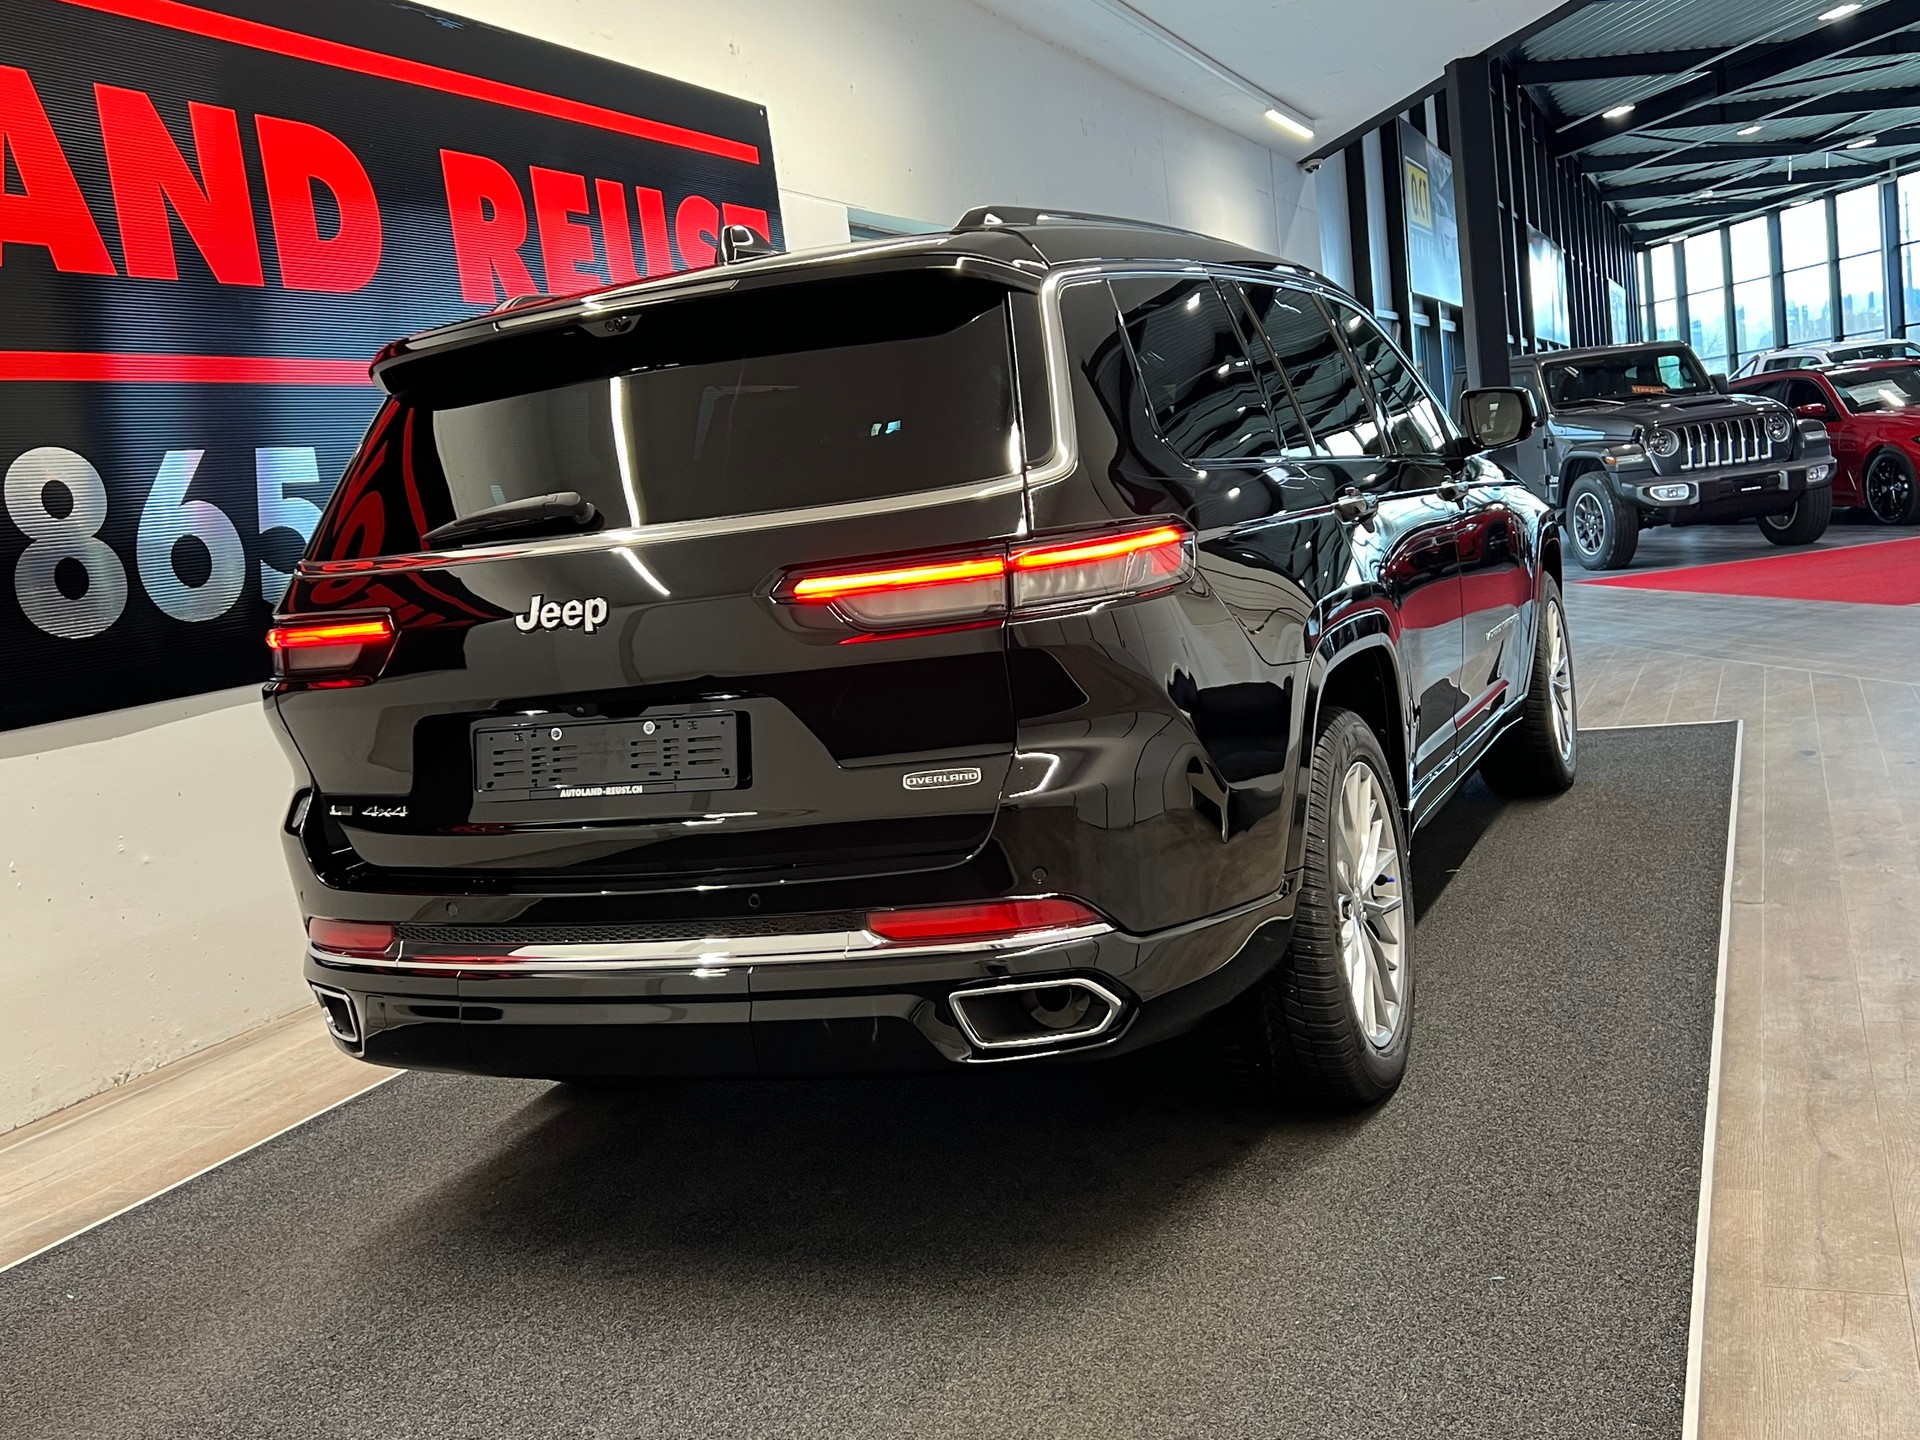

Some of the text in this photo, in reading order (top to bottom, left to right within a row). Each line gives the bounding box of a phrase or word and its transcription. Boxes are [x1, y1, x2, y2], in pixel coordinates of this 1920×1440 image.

[3, 446, 320, 640] 865
[515, 595, 608, 633] Jeep
[559, 785, 643, 798] AUTOLAND-REUST.CH
[905, 771, 978, 787] OVERLAND
